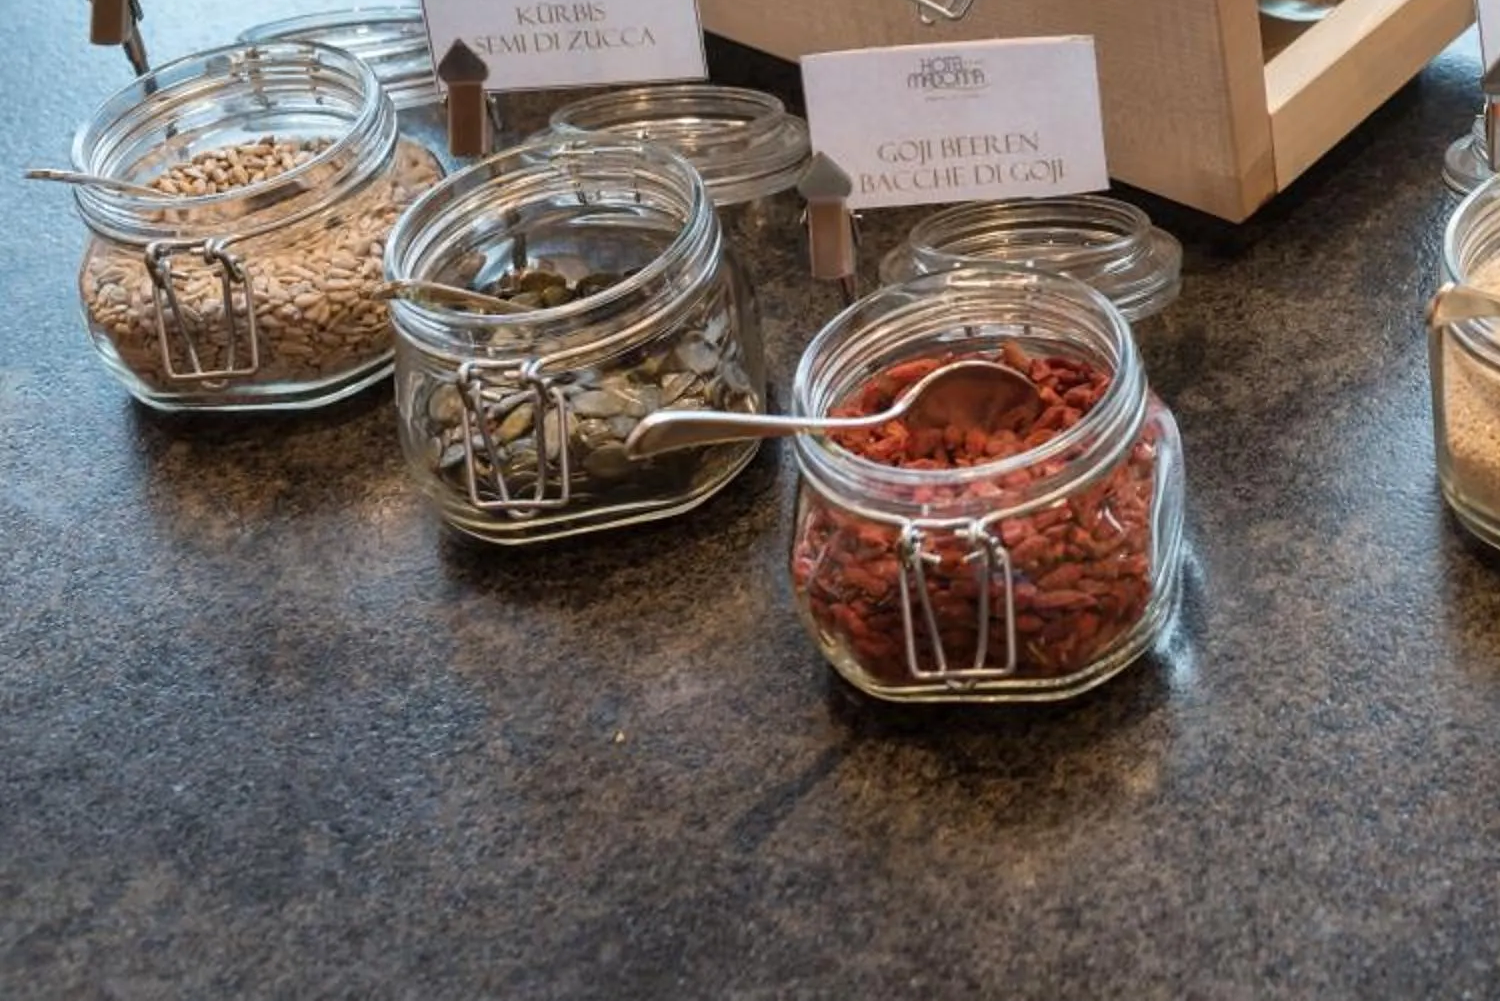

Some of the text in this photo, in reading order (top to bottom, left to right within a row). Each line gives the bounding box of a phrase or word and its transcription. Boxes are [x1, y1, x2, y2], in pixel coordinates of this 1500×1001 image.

[516, 1, 606, 26] KÜRBIS
[475, 27, 656, 55] SEMI DI ZUCCA
[877, 131, 1040, 166] GOJI BEEREN
[860, 159, 1064, 194] BACCHE DI GOJI
